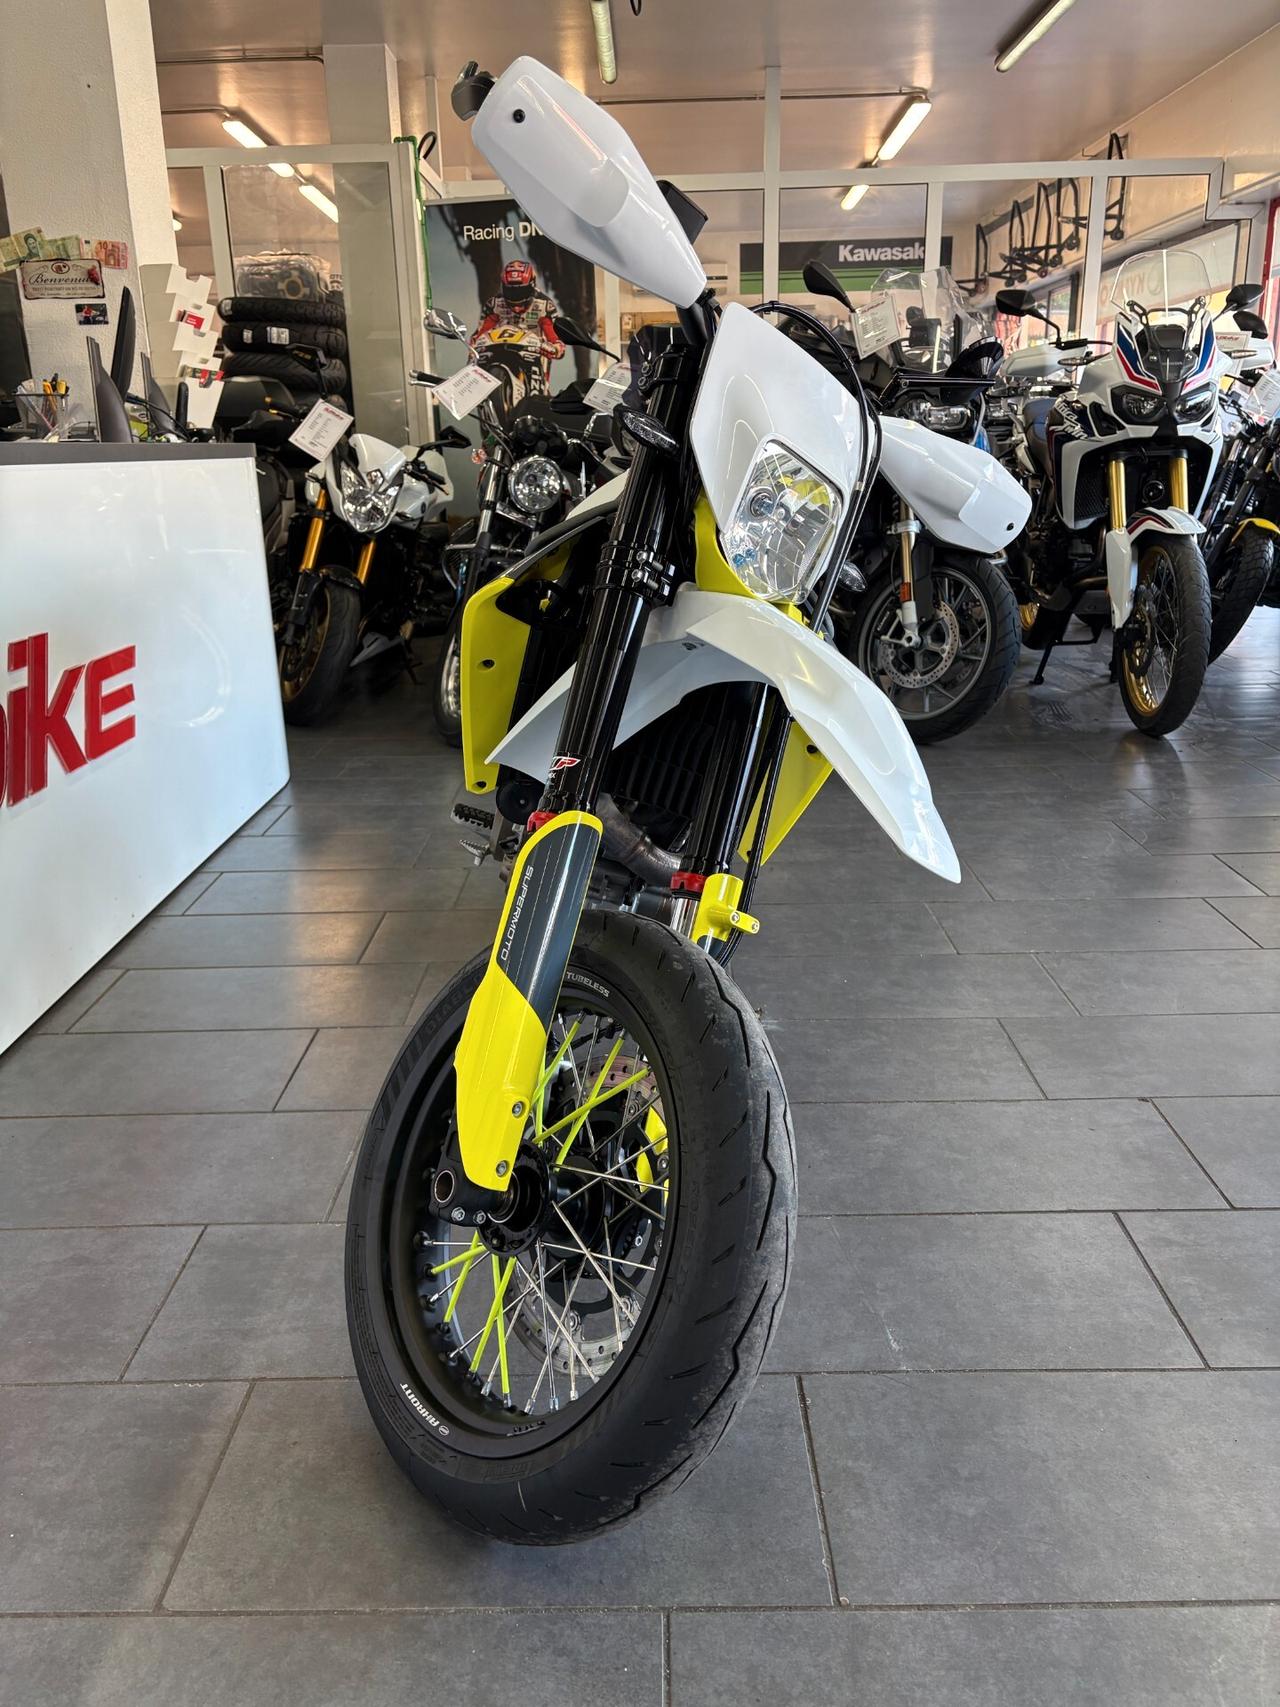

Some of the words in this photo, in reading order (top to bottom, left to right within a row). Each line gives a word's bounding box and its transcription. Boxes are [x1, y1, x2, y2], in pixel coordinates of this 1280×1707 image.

[463, 223, 515, 242] Racing
[518, 221, 545, 238] DN
[838, 242, 925, 262] Kawasak
[500, 865, 534, 961] SUPERMOTO
[566, 971, 610, 998] TUBELESS
